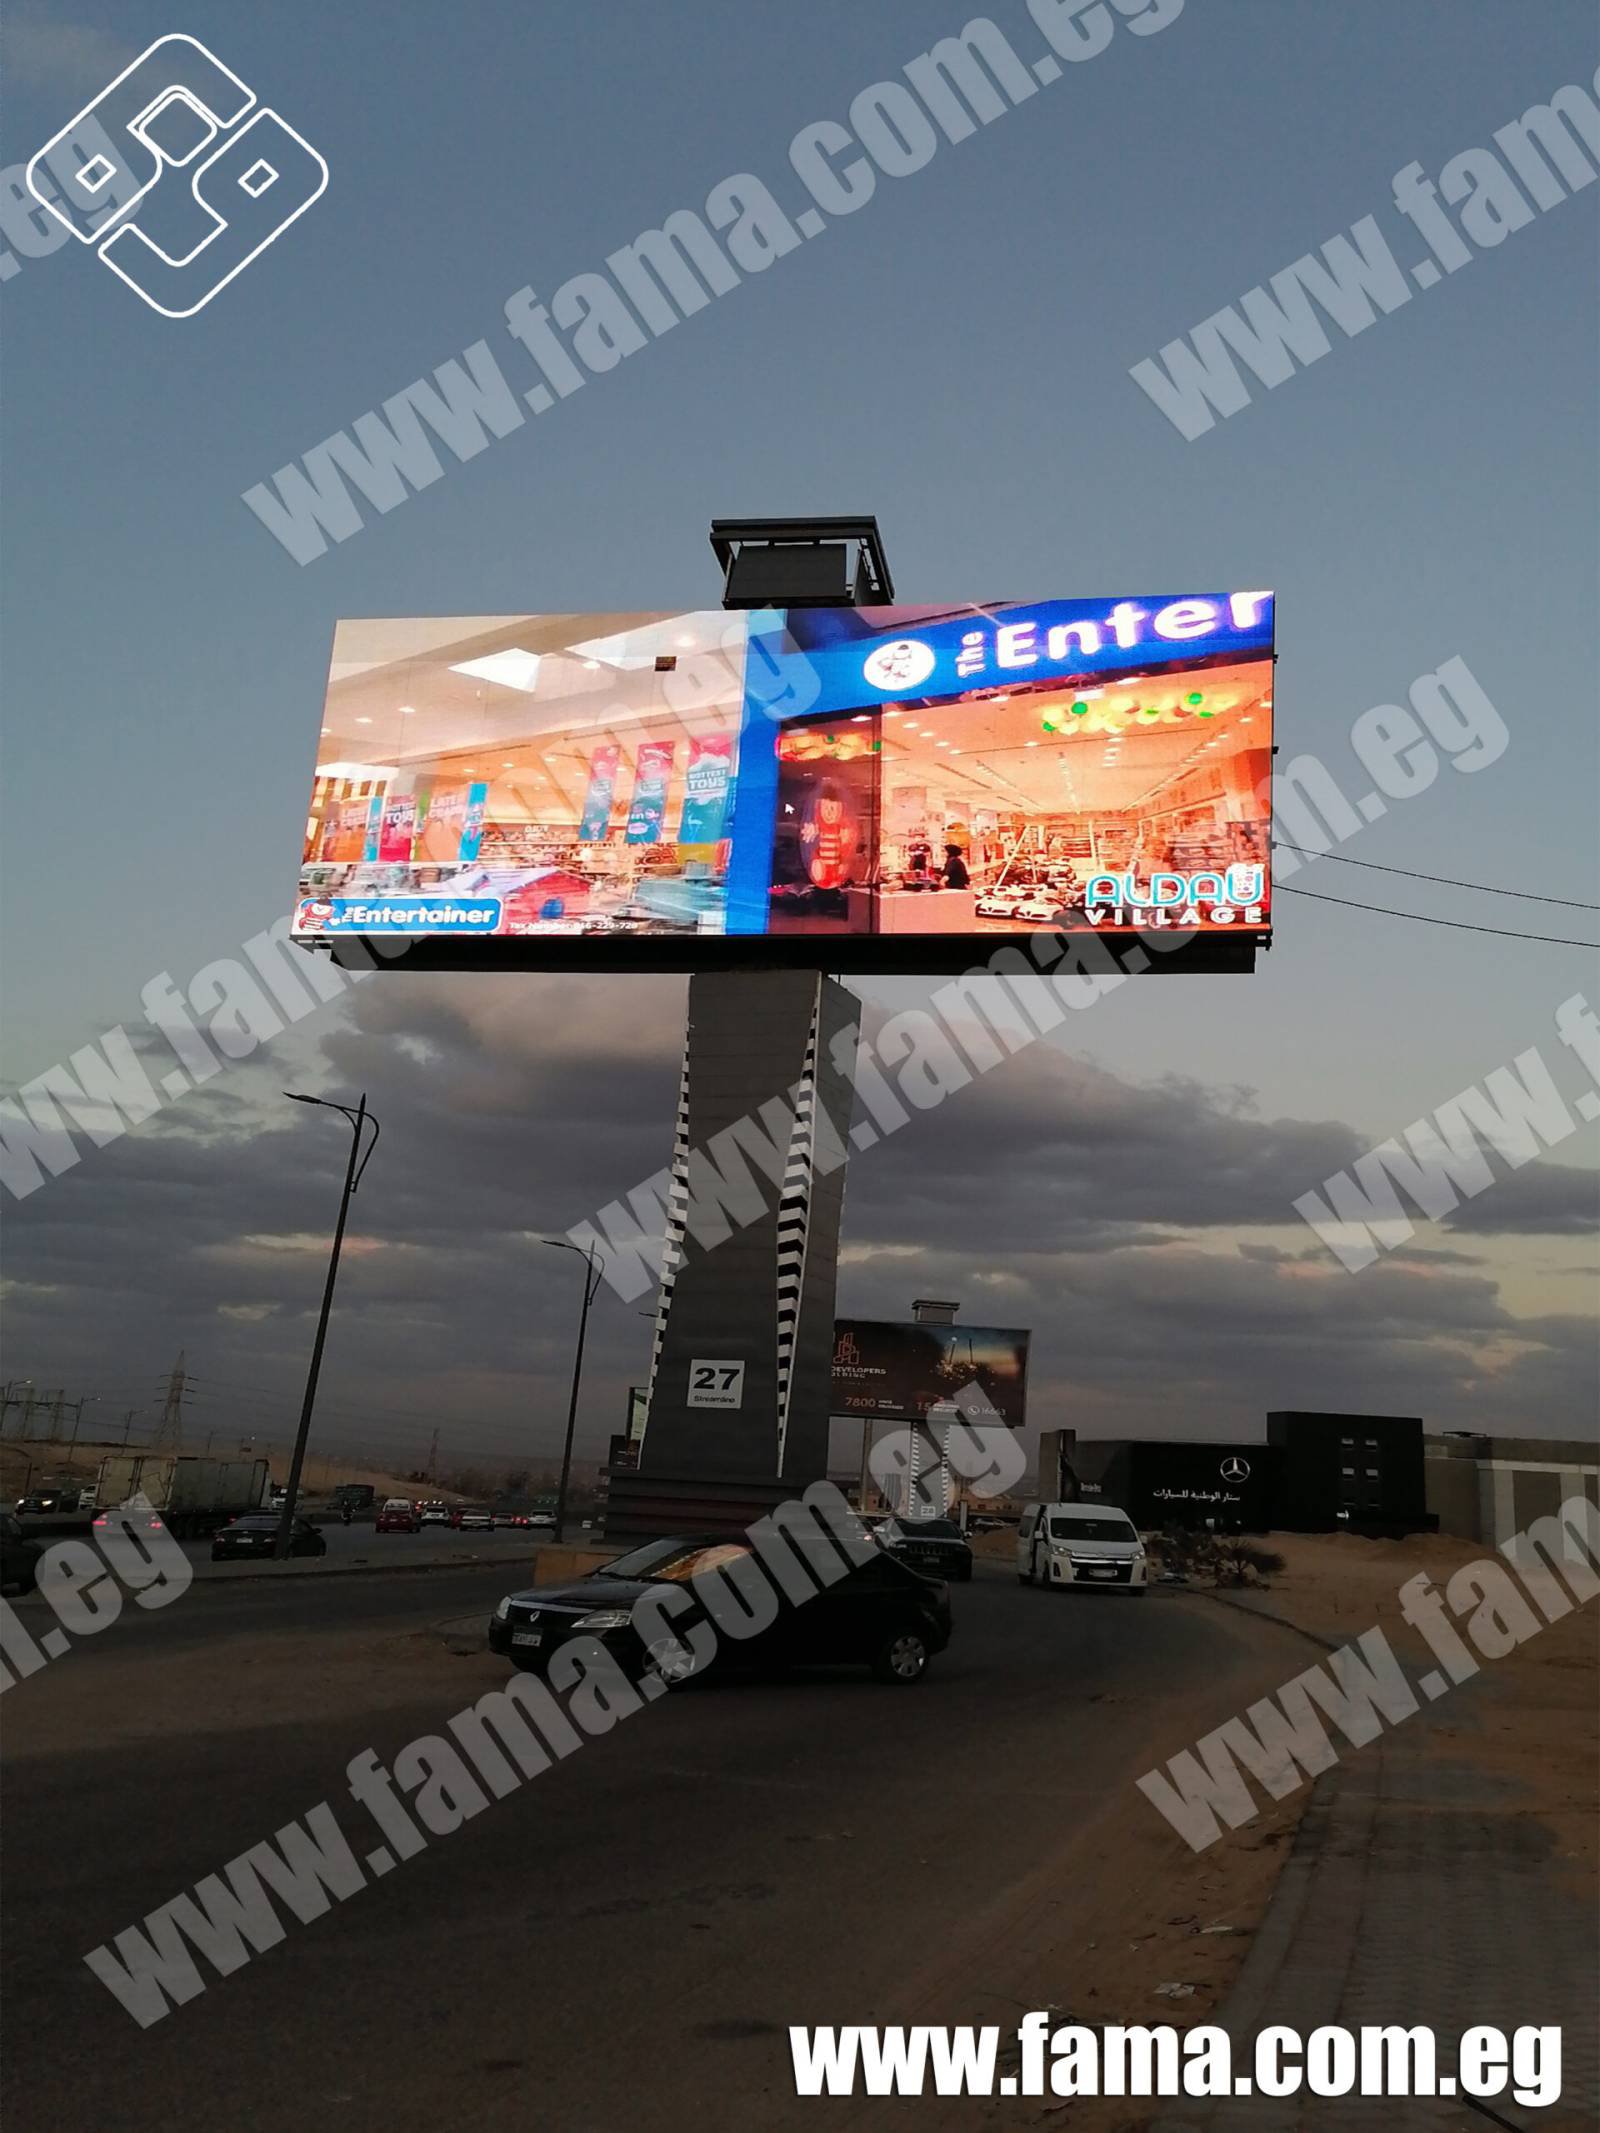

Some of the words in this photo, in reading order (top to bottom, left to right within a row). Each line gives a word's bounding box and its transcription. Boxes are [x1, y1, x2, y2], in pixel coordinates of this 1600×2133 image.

[955, 631, 985, 678] The
[997, 591, 1275, 669] Enter
[1085, 865, 1265, 908] ALDAU
[354, 905, 495, 924] Entertainer
[1085, 907, 1262, 926] VILLAGE
[693, 1367, 740, 1390] 27
[844, 1396, 877, 1408] 7800
